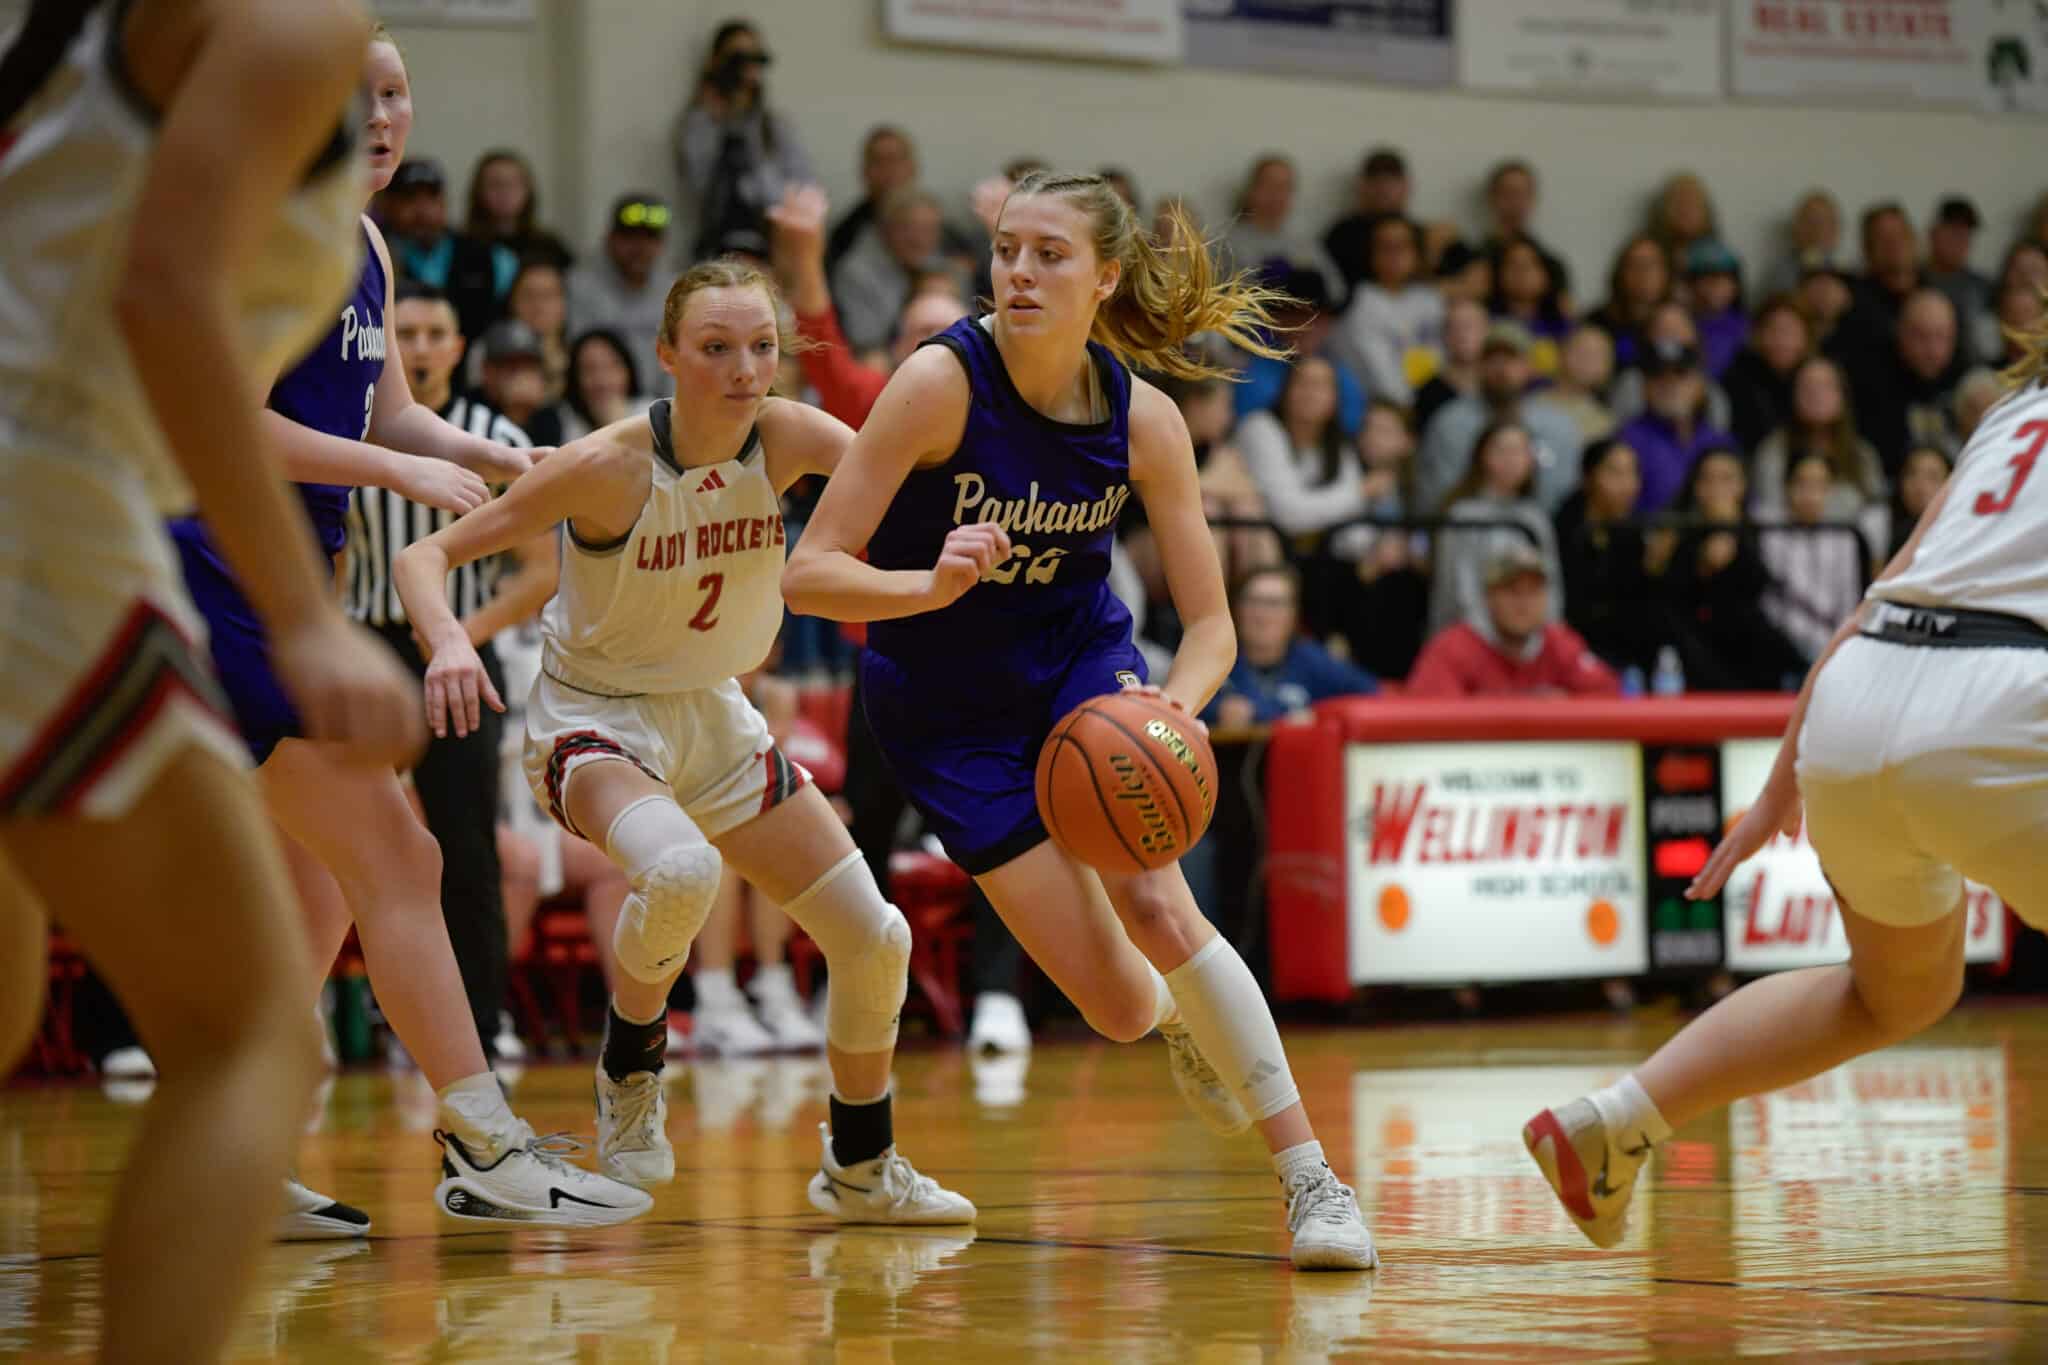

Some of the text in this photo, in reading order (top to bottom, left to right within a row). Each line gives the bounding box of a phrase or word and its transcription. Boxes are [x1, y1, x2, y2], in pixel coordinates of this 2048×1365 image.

[1973, 417, 2048, 517] 3
[637, 512, 785, 572] LADY ROCKETS
[688, 572, 724, 633] 2
[1367, 783, 1628, 867] WELLINGTON
[1473, 872, 1632, 896] HIGH SCHOOL
